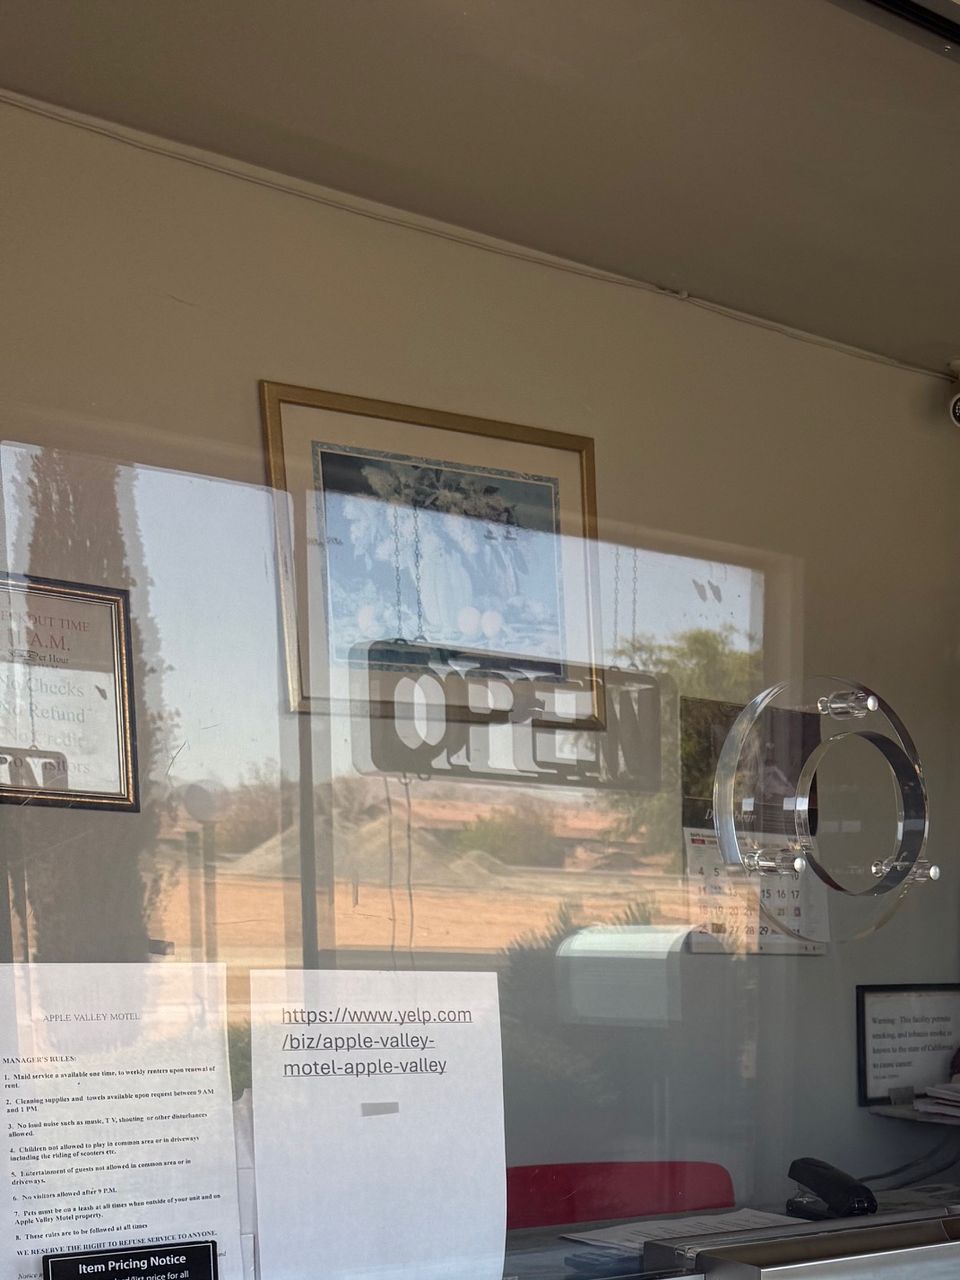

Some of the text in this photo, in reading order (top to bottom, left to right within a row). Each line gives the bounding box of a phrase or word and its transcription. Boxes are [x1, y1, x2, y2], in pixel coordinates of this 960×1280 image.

[60, 618, 90, 632] TIME
[30, 632, 71, 651] A.M.
[27, 677, 84, 698] Checks
[30, 703, 85, 723] Refund
[43, 1014, 72, 1022] APPLE
[74, 1013, 108, 1021] VALLEY
[281, 1007, 473, 1025] https://www.yelp.com
[282, 1033, 436, 1052] /biz/apple-valley-
[2, 1055, 77, 1064] MANAGER'S RULES:
[283, 1058, 448, 1077] motel-apple-valley
[15, 1097, 44, 1105] Cleaning
[151, 1091, 172, 1099] request
[60, 1143, 84, 1151] allowed
[92, 1141, 105, 1150] play
[170, 1135, 200, 1143] driveways
[10, 1153, 40, 1161] including
[52, 1151, 72, 1159] riding
[57, 1190, 80, 1198] allowed
[82, 1188, 96, 1196] after
[15, 1218, 34, 1226] Apple
[56, 1214, 74, 1222] Motel
[75, 1212, 103, 1221] property.
[89, 1225, 115, 1234] followed
[31, 1246, 65, 1256] RESERVE
[83, 1242, 106, 1250] RIGHT
[119, 1238, 146, 1247] REFUSE
[147, 1234, 176, 1243] SERVICE
[187, 1230, 218, 1239] ANYONE.
[79, 1254, 187, 1274] Item Pricing Notice
[167, 1272, 179, 1280] for
[180, 1270, 189, 1279] all
